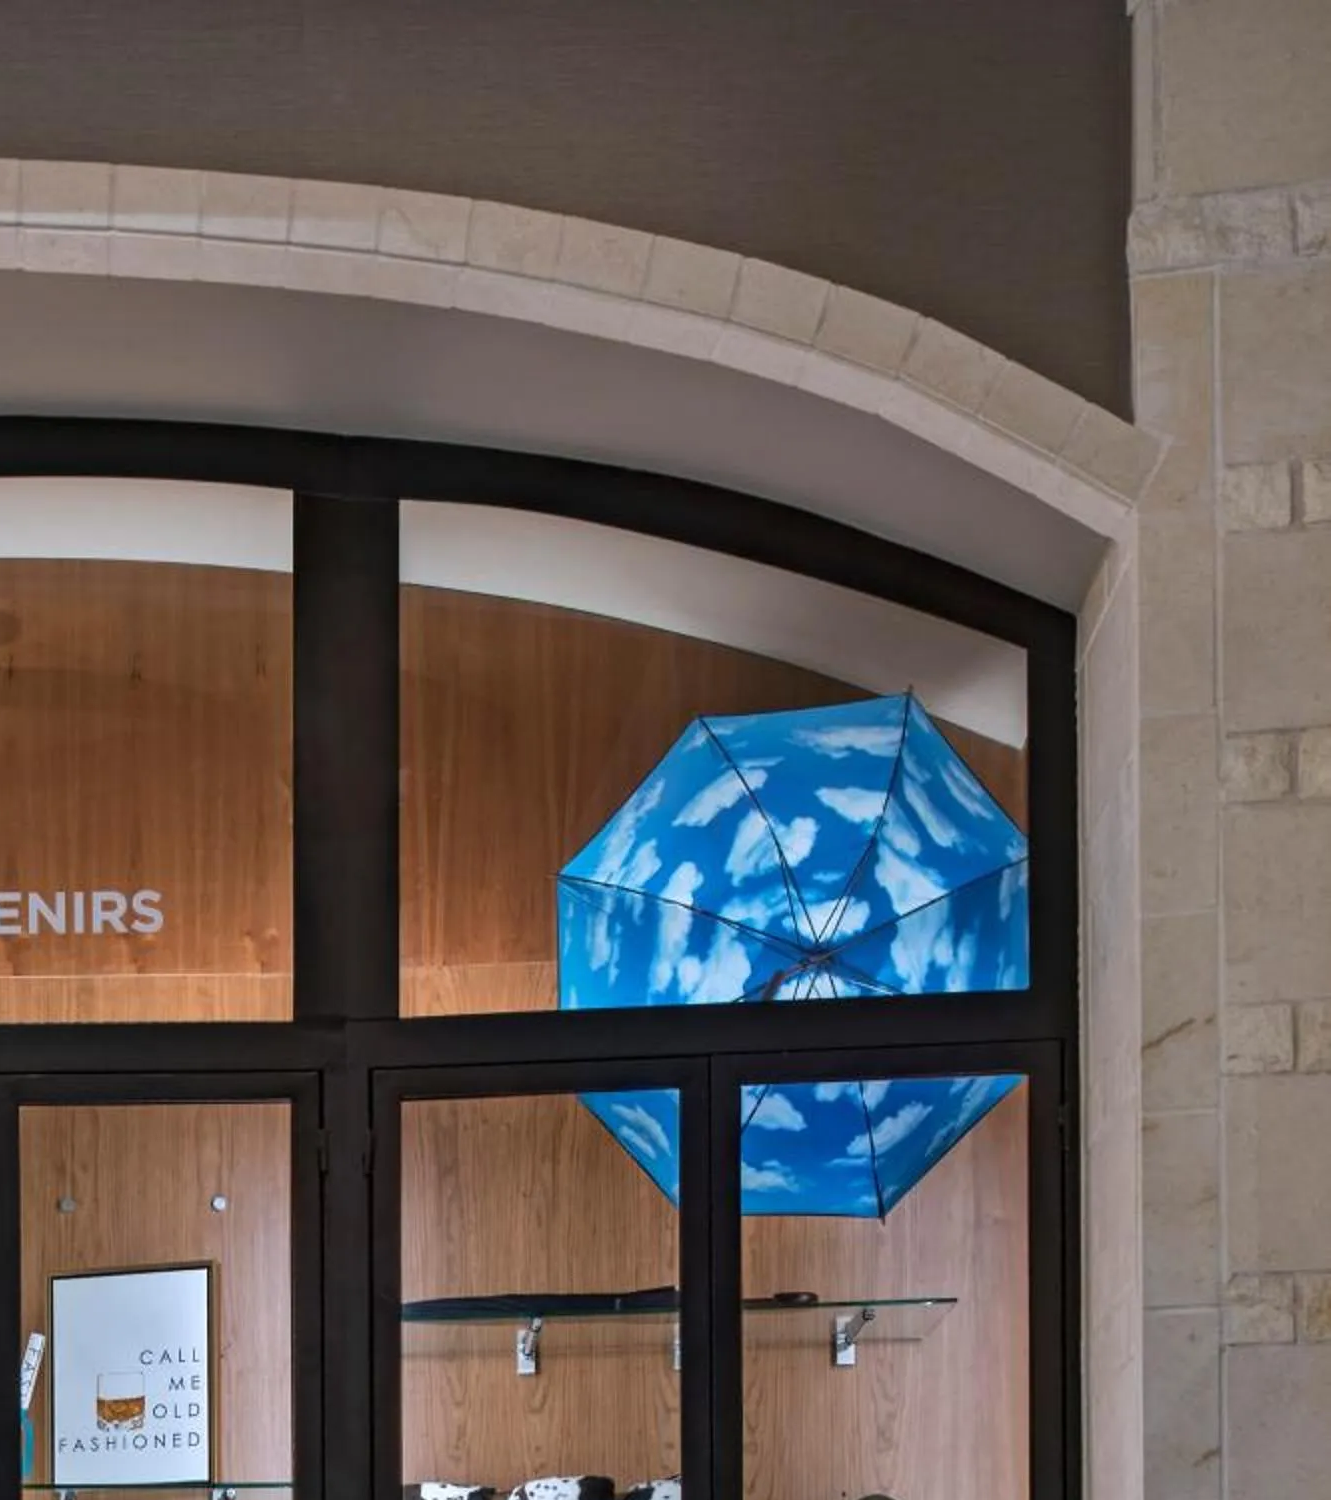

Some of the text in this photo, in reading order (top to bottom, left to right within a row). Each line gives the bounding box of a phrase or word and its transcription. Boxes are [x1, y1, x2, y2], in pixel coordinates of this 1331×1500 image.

[139, 1348, 201, 1366] CALL
[168, 1375, 201, 1391] ME
[152, 1403, 201, 1419] OLD
[58, 1432, 201, 1454] FASHIONED
